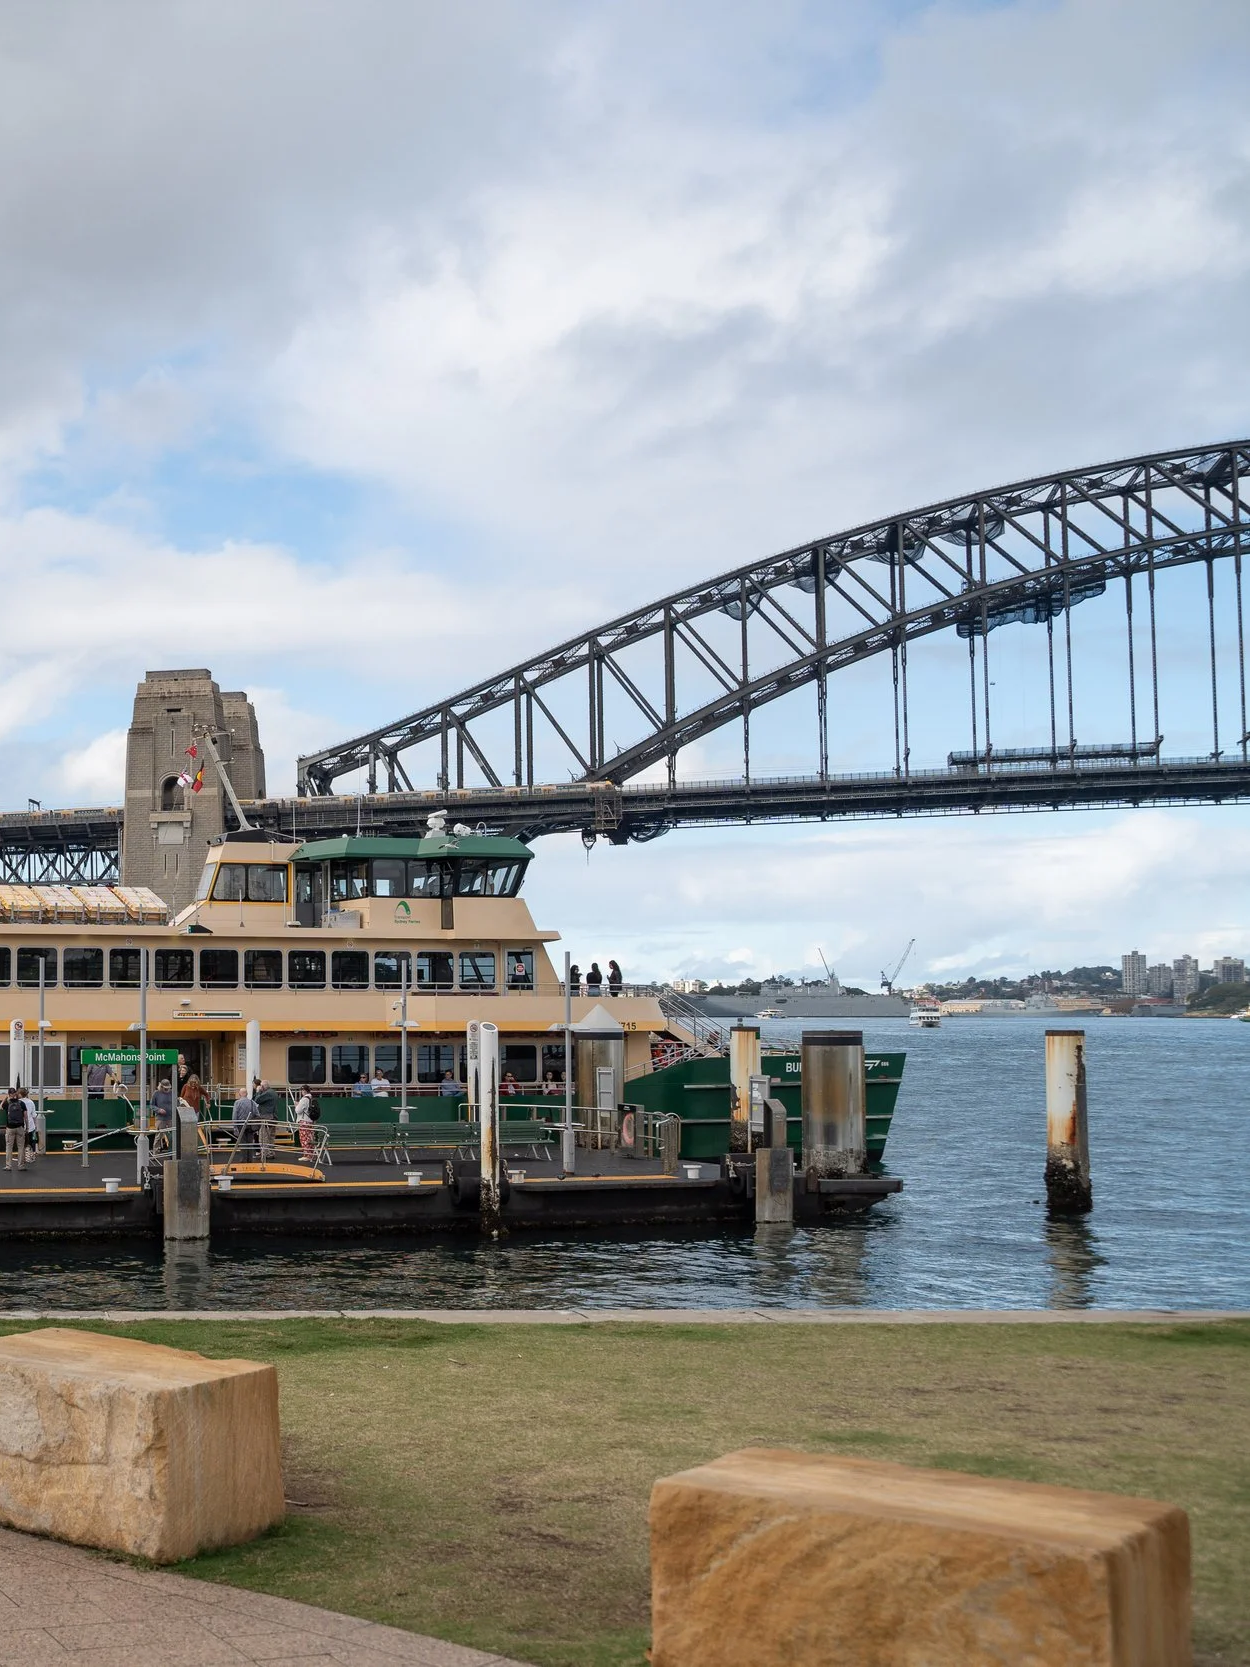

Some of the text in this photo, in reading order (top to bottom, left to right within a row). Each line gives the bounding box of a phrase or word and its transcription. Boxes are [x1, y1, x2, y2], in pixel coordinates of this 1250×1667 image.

[618, 1021, 636, 1030] 715
[95, 1052, 142, 1062] McMahons
[785, 1062, 802, 1073] BU
